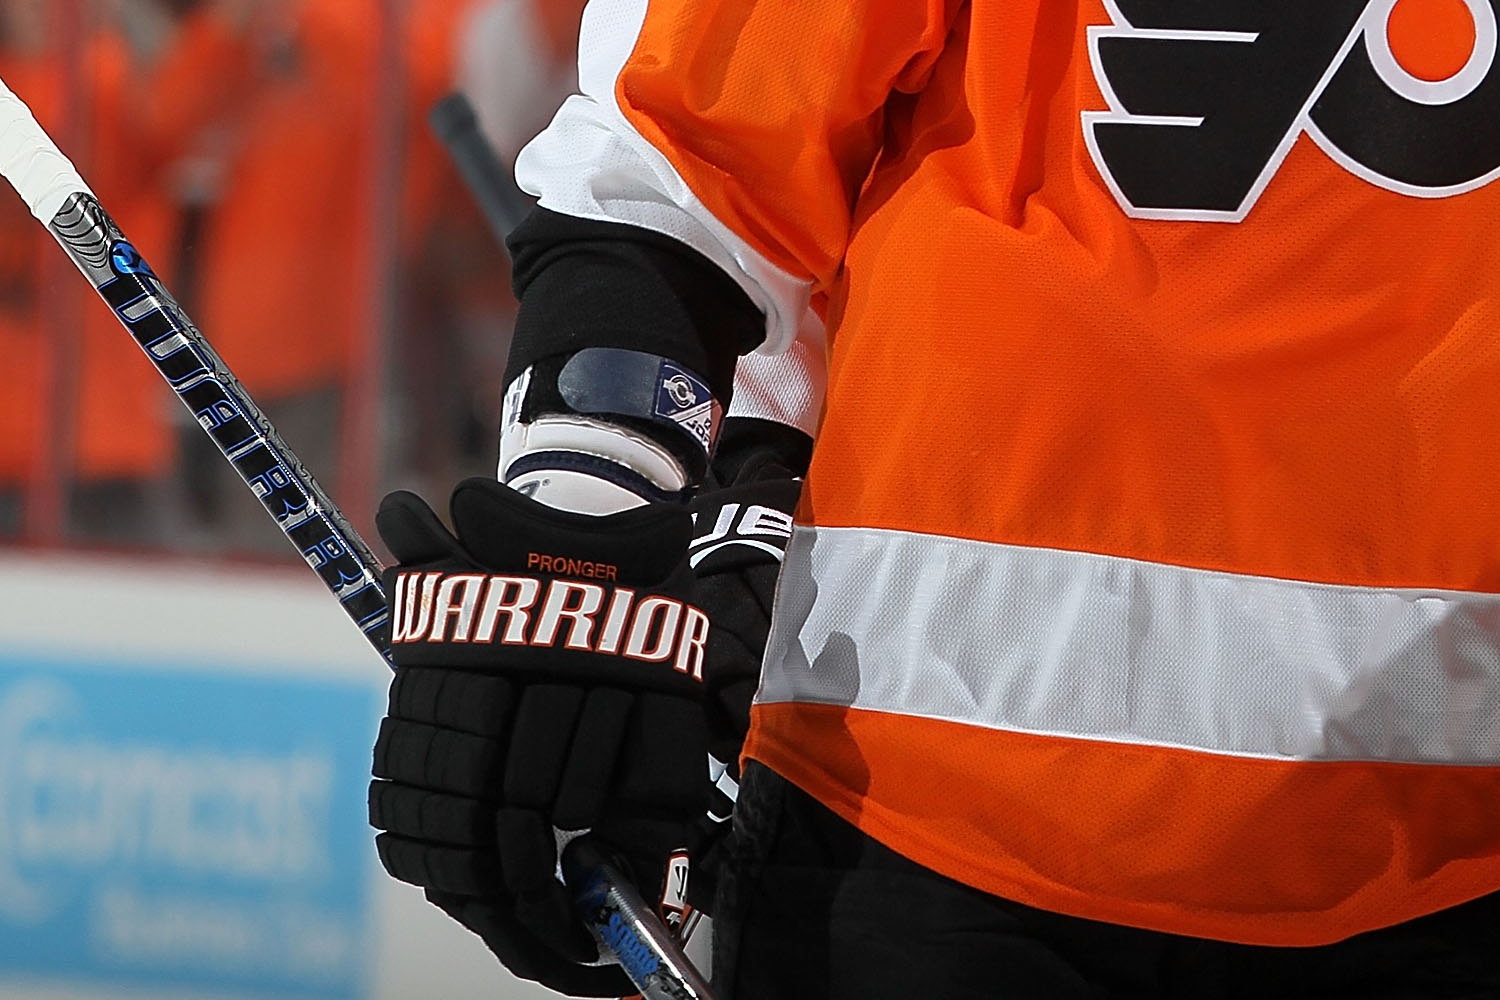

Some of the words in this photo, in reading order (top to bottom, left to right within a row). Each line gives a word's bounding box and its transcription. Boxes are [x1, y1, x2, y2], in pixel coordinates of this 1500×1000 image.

[97, 270, 396, 668] WARRI
[527, 552, 619, 580] PRONGER
[391, 570, 711, 682] WARRIOR
